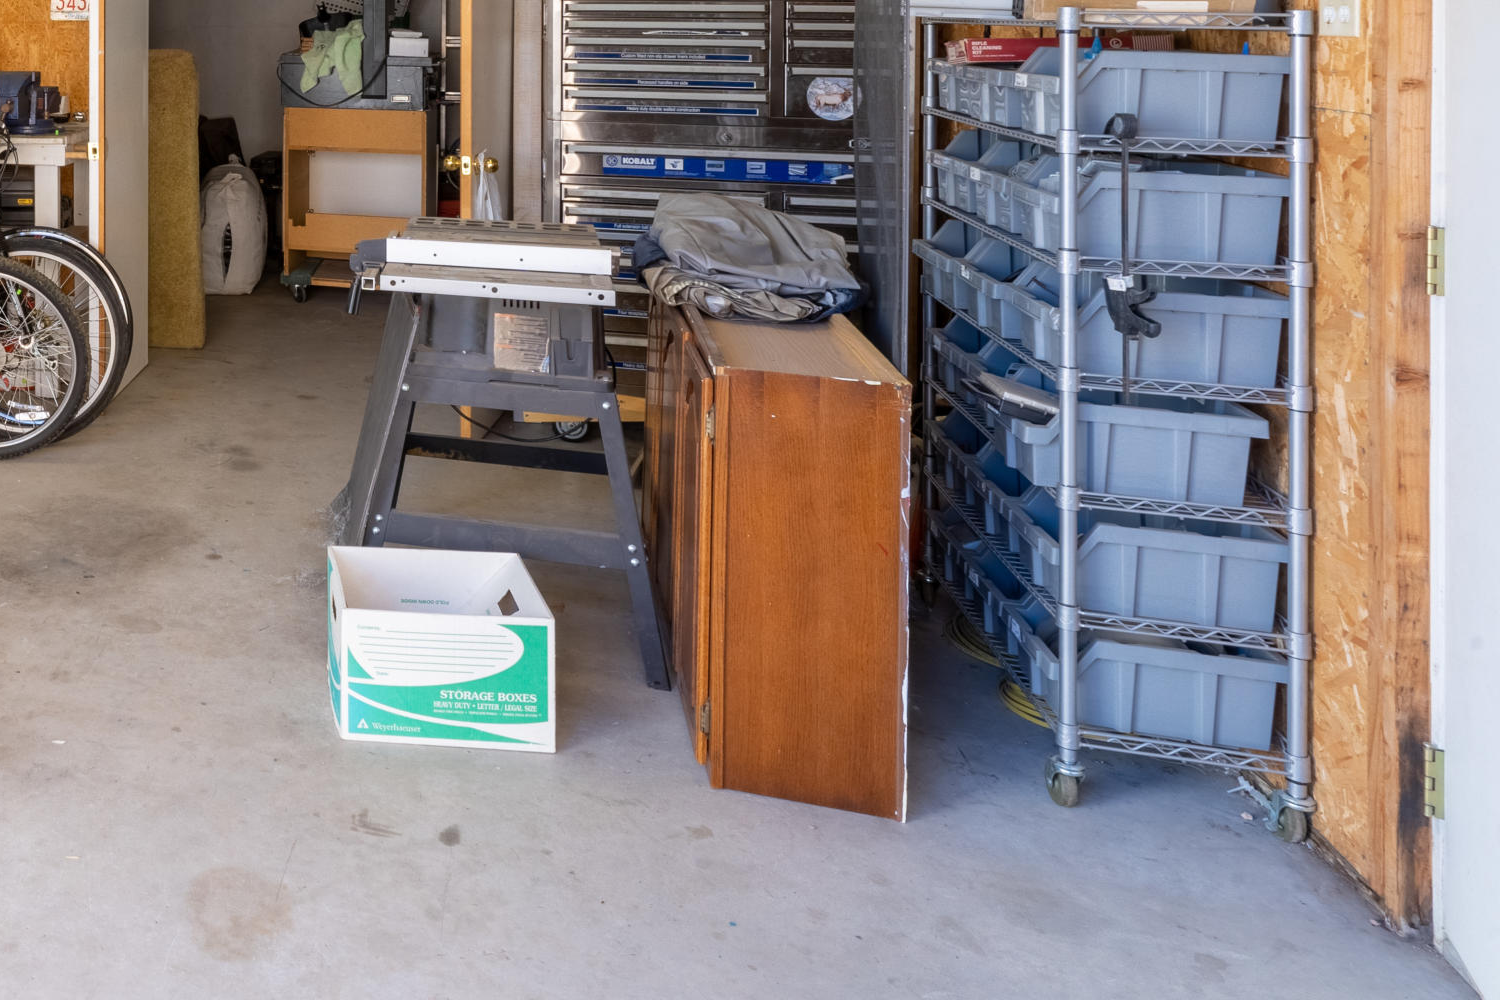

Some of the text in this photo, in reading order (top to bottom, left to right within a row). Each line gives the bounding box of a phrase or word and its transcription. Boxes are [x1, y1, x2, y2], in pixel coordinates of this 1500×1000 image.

[621, 156, 656, 166] KOBALT
[440, 689, 538, 703] STORAGE BOXES
[433, 700, 538, 713] HEAVY DUTY LETTER LEGAL SIZE
[371, 721, 421, 733] Weyerhaeuser
